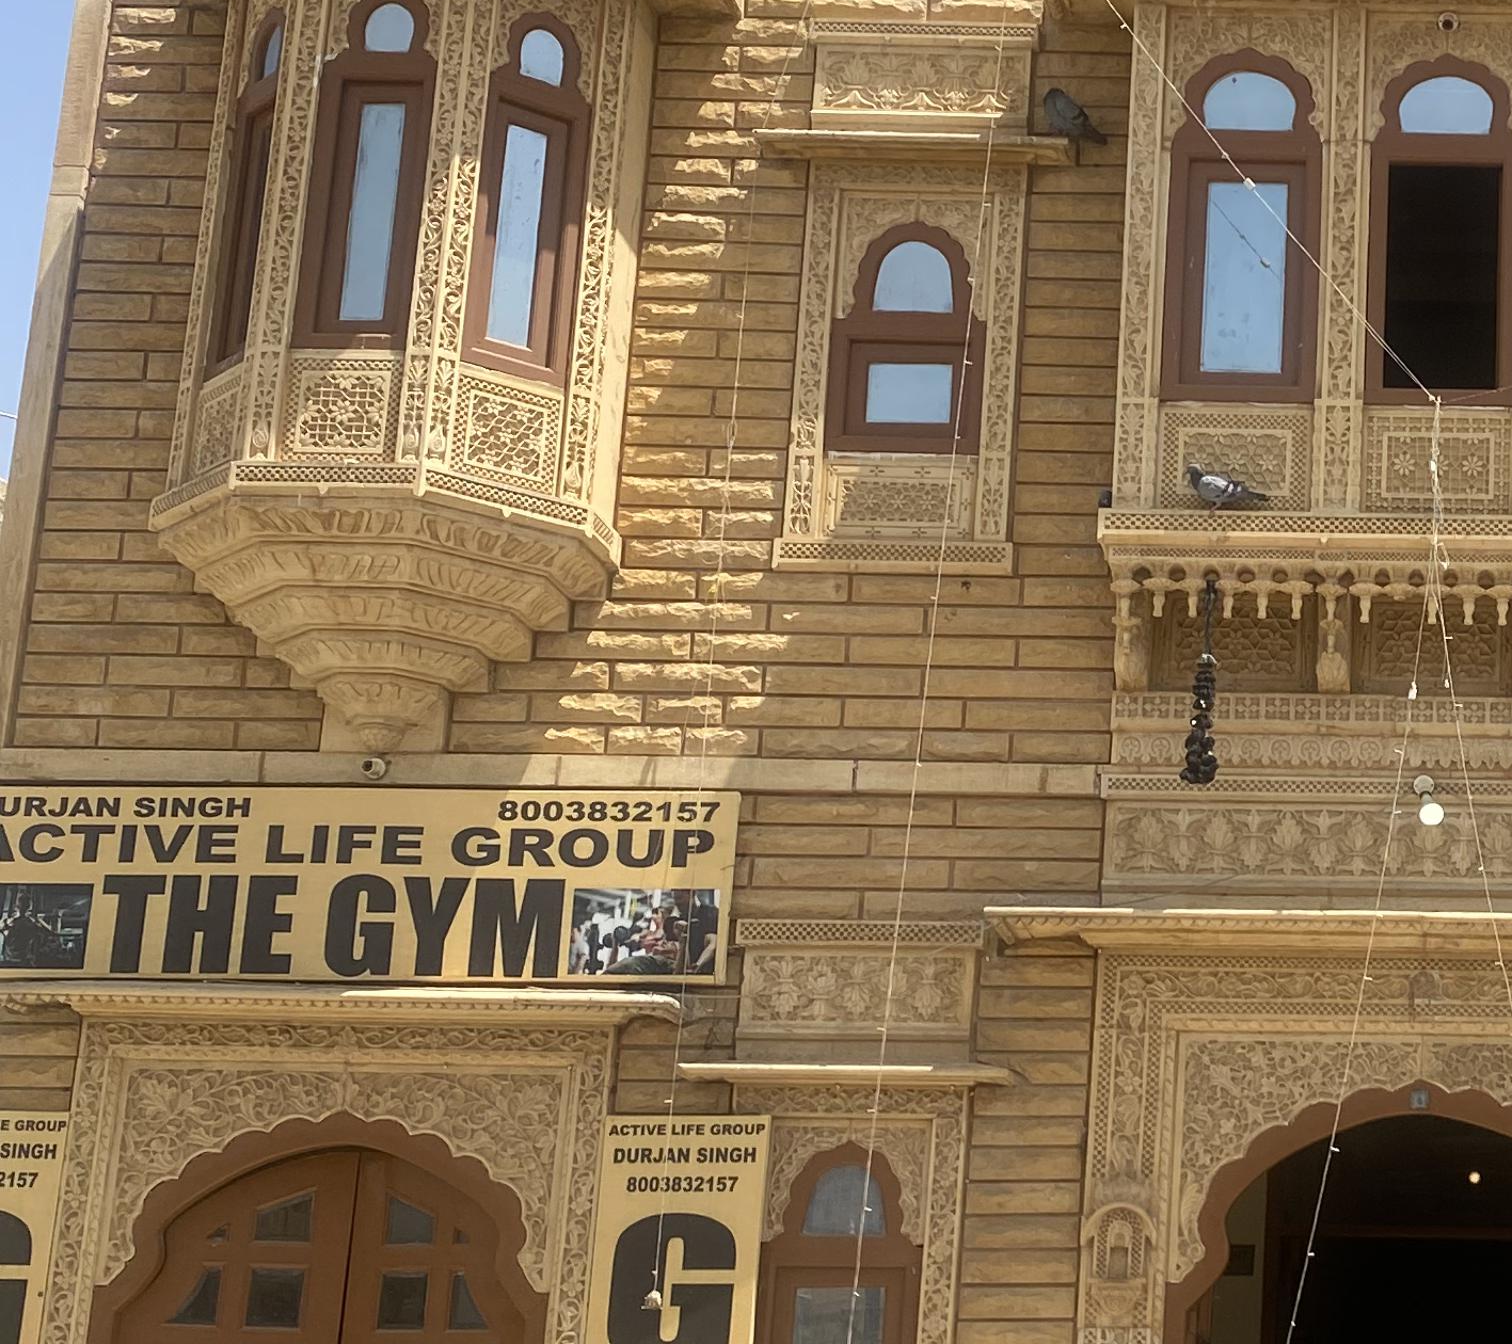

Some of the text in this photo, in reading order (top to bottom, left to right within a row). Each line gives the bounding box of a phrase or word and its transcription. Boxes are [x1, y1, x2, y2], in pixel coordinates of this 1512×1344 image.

[132, 796, 252, 818] SINGH
[497, 799, 721, 824] 8003832157
[265, 824, 424, 866] LIFE
[449, 827, 716, 869] GROUP
[101, 874, 567, 978] THE GYM
[14, 1119, 68, 1133] GROUP
[608, 1122, 766, 1137] ACTIVE LIFE GROUP
[0, 1142, 57, 1160] SINGH
[613, 1146, 757, 1164] DURJAN SINGH
[626, 1175, 739, 1193] 8003832157
